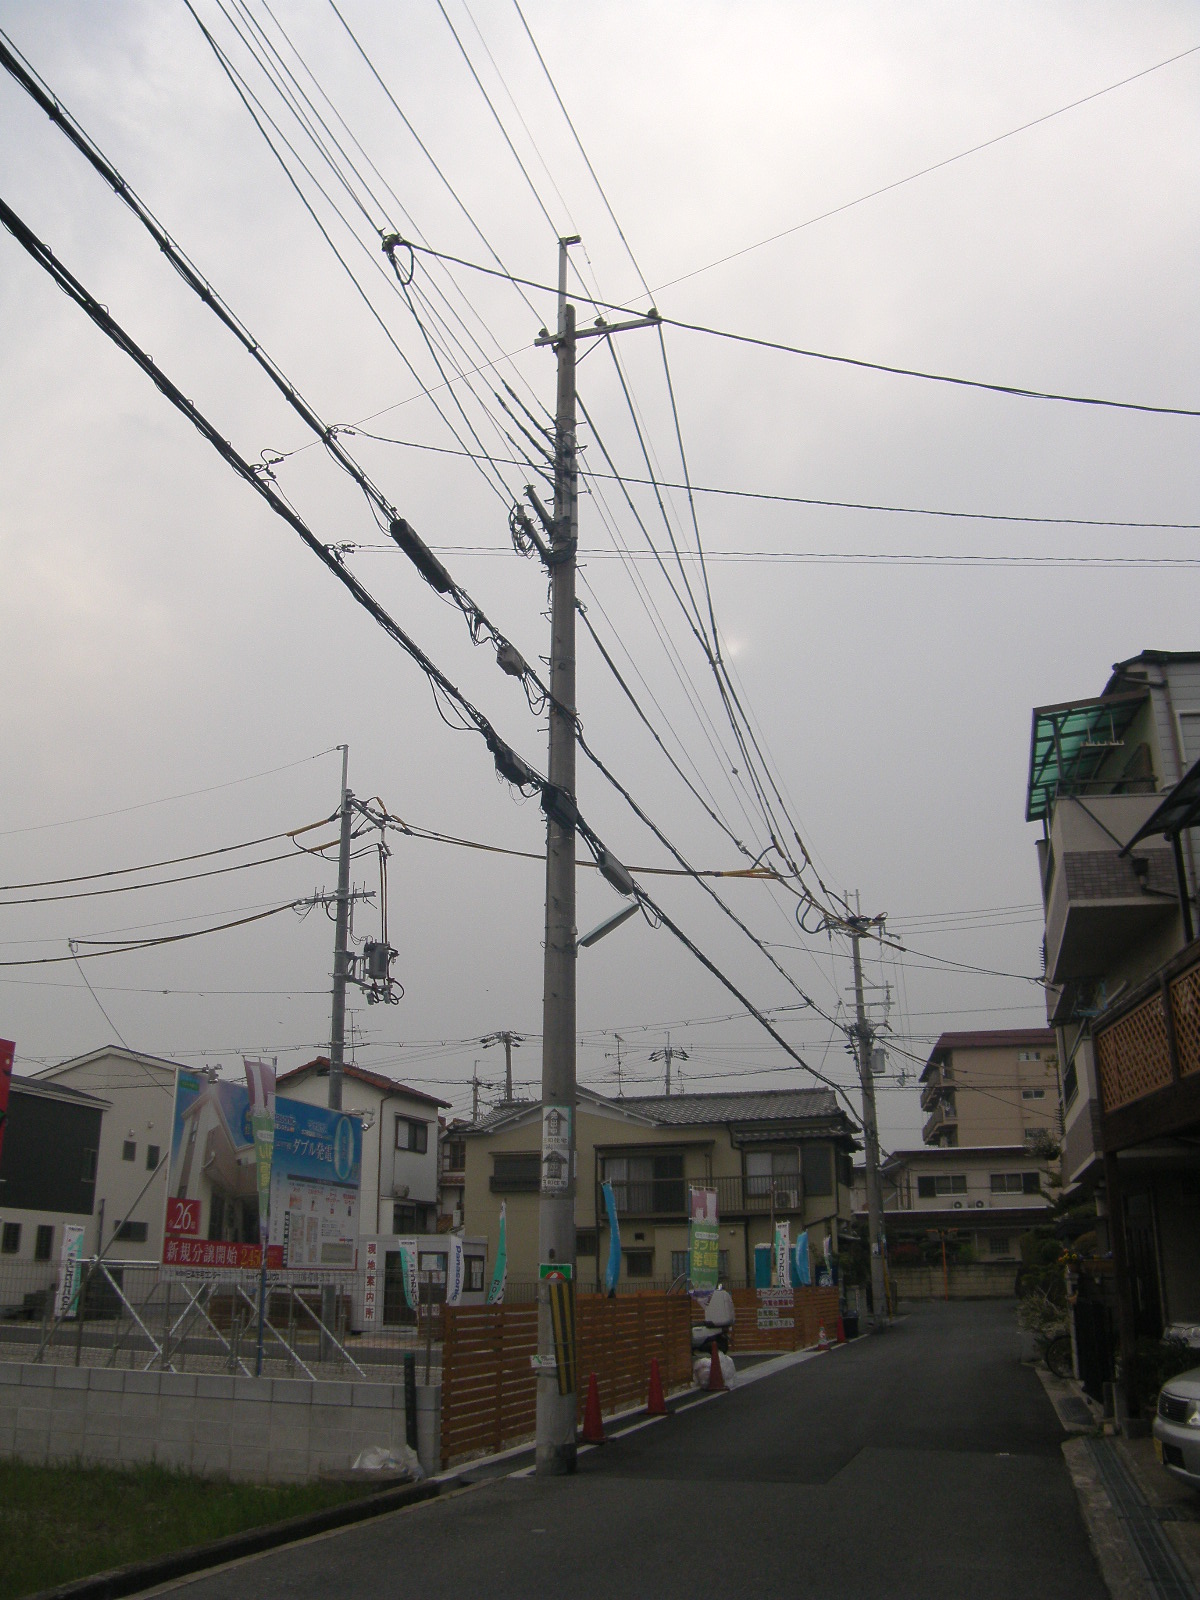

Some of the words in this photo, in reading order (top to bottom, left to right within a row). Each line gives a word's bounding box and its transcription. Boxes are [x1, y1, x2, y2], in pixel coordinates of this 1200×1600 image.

[293, 1139, 333, 1162] ダブル発電
[167, 1241, 238, 1265] 新規分譲開始
[452, 1245, 462, 1301] Panasonic
[366, 1244, 377, 1319] 現地案内所
